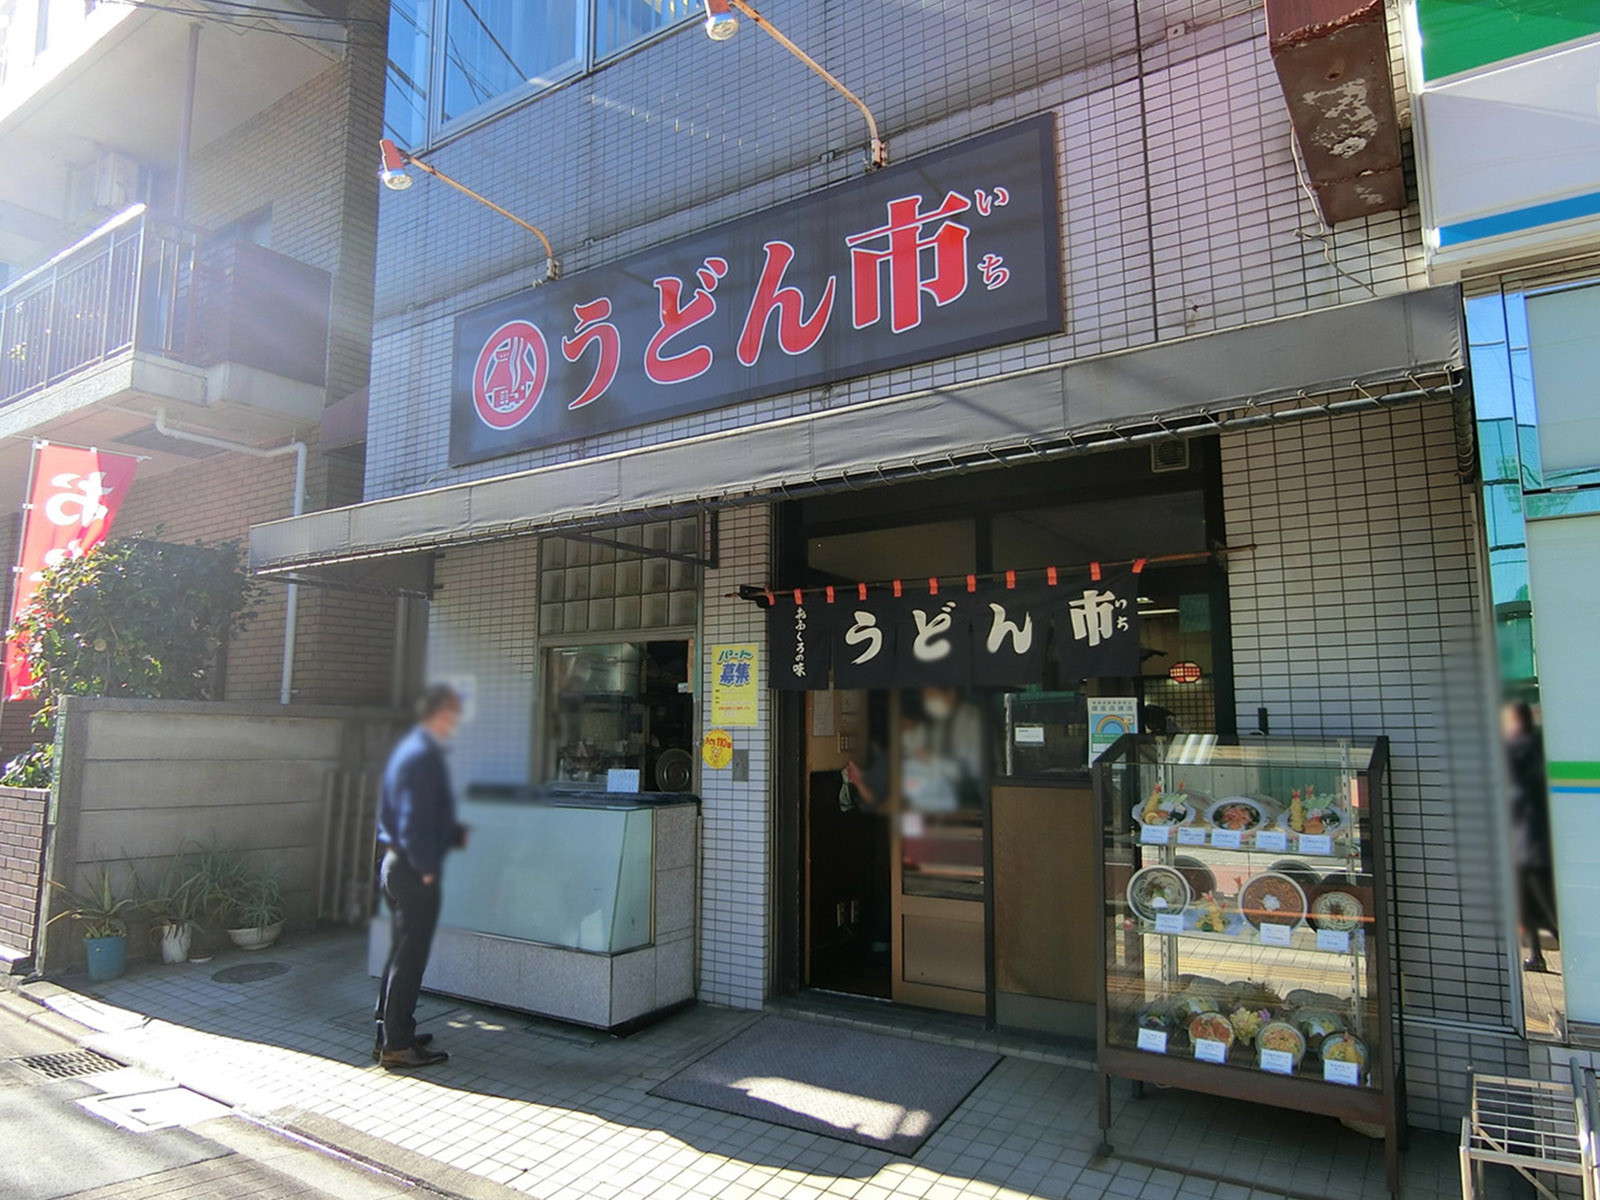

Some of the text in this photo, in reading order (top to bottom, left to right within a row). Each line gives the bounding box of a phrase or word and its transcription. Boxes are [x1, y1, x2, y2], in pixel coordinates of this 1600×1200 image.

[974, 186, 1010, 291] いち
[561, 190, 970, 410] うどん市
[792, 606, 808, 677] おふくろの味
[844, 590, 1116, 665] うどん市
[1114, 598, 1130, 632] いち
[717, 649, 753, 664] パート
[719, 662, 751, 685] 募集
